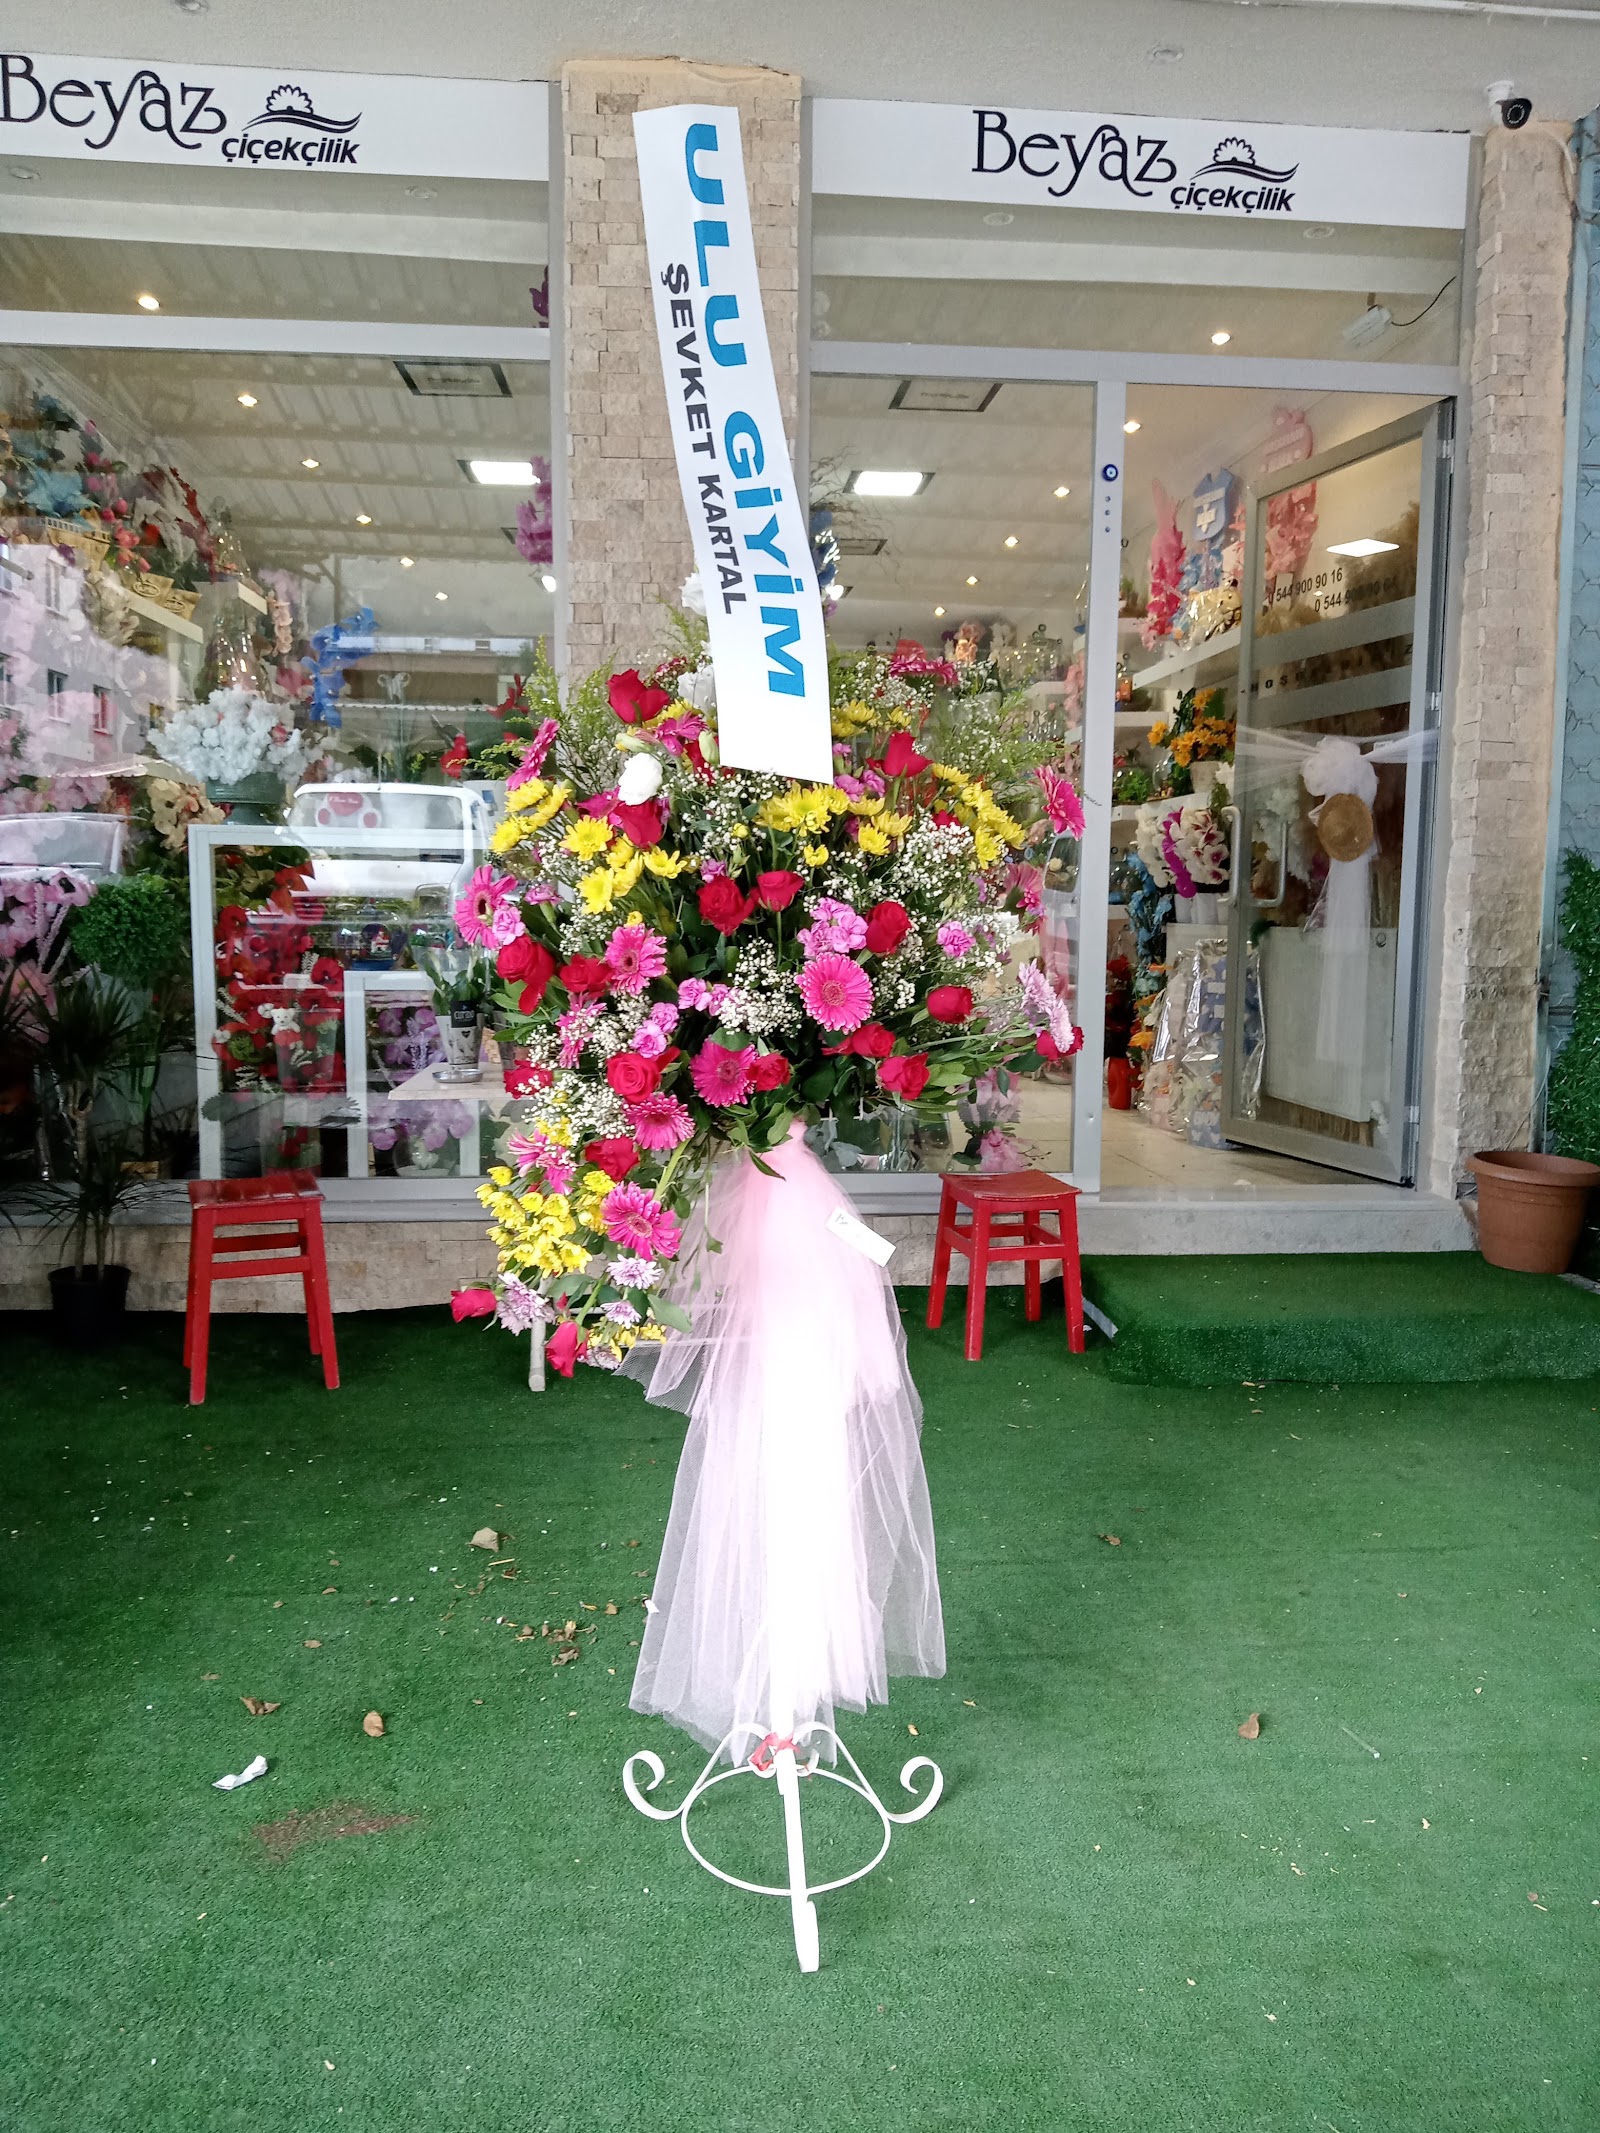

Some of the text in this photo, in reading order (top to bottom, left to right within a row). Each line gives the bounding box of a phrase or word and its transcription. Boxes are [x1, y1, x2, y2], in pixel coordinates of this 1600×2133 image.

[0, 54, 227, 149] Beyaz
[221, 133, 360, 167] çiçekçilik
[972, 110, 1177, 197] Beyaz
[1170, 182, 1296, 213] çiçekçilik
[661, 263, 747, 614] ŞEVKET KARTAL
[685, 123, 805, 697] ULU GİYİM
[1295, 578, 1313, 596] 900
[1315, 573, 1327, 589] 90
[1331, 567, 1343, 584] 16
[1314, 599, 1320, 612] 0
[1324, 592, 1341, 610] 544
